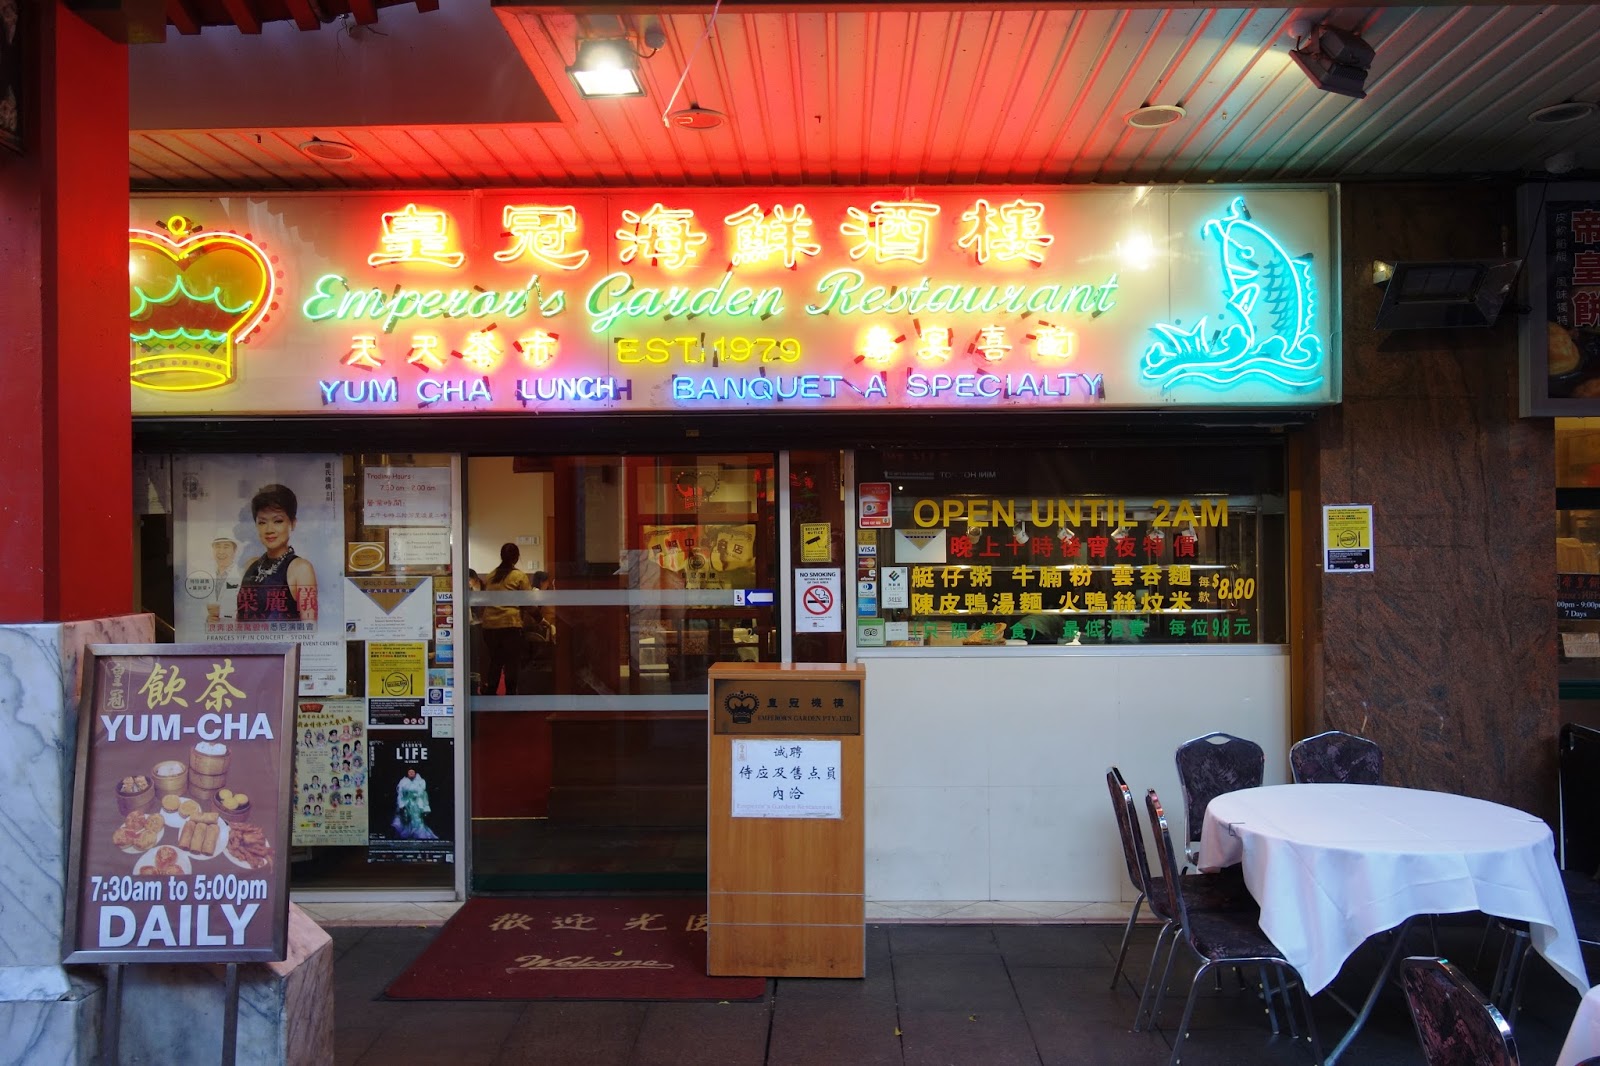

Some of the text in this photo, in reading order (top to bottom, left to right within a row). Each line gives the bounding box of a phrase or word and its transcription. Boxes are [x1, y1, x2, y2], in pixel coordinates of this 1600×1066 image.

[367, 199, 1055, 271] 皇冠海鮮酒樓
[303, 268, 1119, 334] Emperor's Garden Restaurant
[319, 376, 615, 404] YUM CHA LUNCH
[673, 374, 1104, 402] BANQUET A SPECIALTY
[913, 498, 1229, 528] OPEN UNTIL 2AM
[949, 534, 1197, 559] 晚上十時後宵夜特價
[1212, 572, 1256, 602] $8.80
[1571, 610, 1588, 620] Days
[290, 633, 315, 641] SYDNEY
[138, 658, 247, 713] 飲茶
[101, 712, 274, 743] YUM-CHA
[794, 714, 821, 722] GARDEN
[395, 747, 428, 761] LIFE
[774, 746, 803, 760] 诚聘
[92, 874, 268, 907] 7:30am to 5:00pm
[99, 904, 261, 949] DAILY
[510, 953, 668, 970] Welcome
